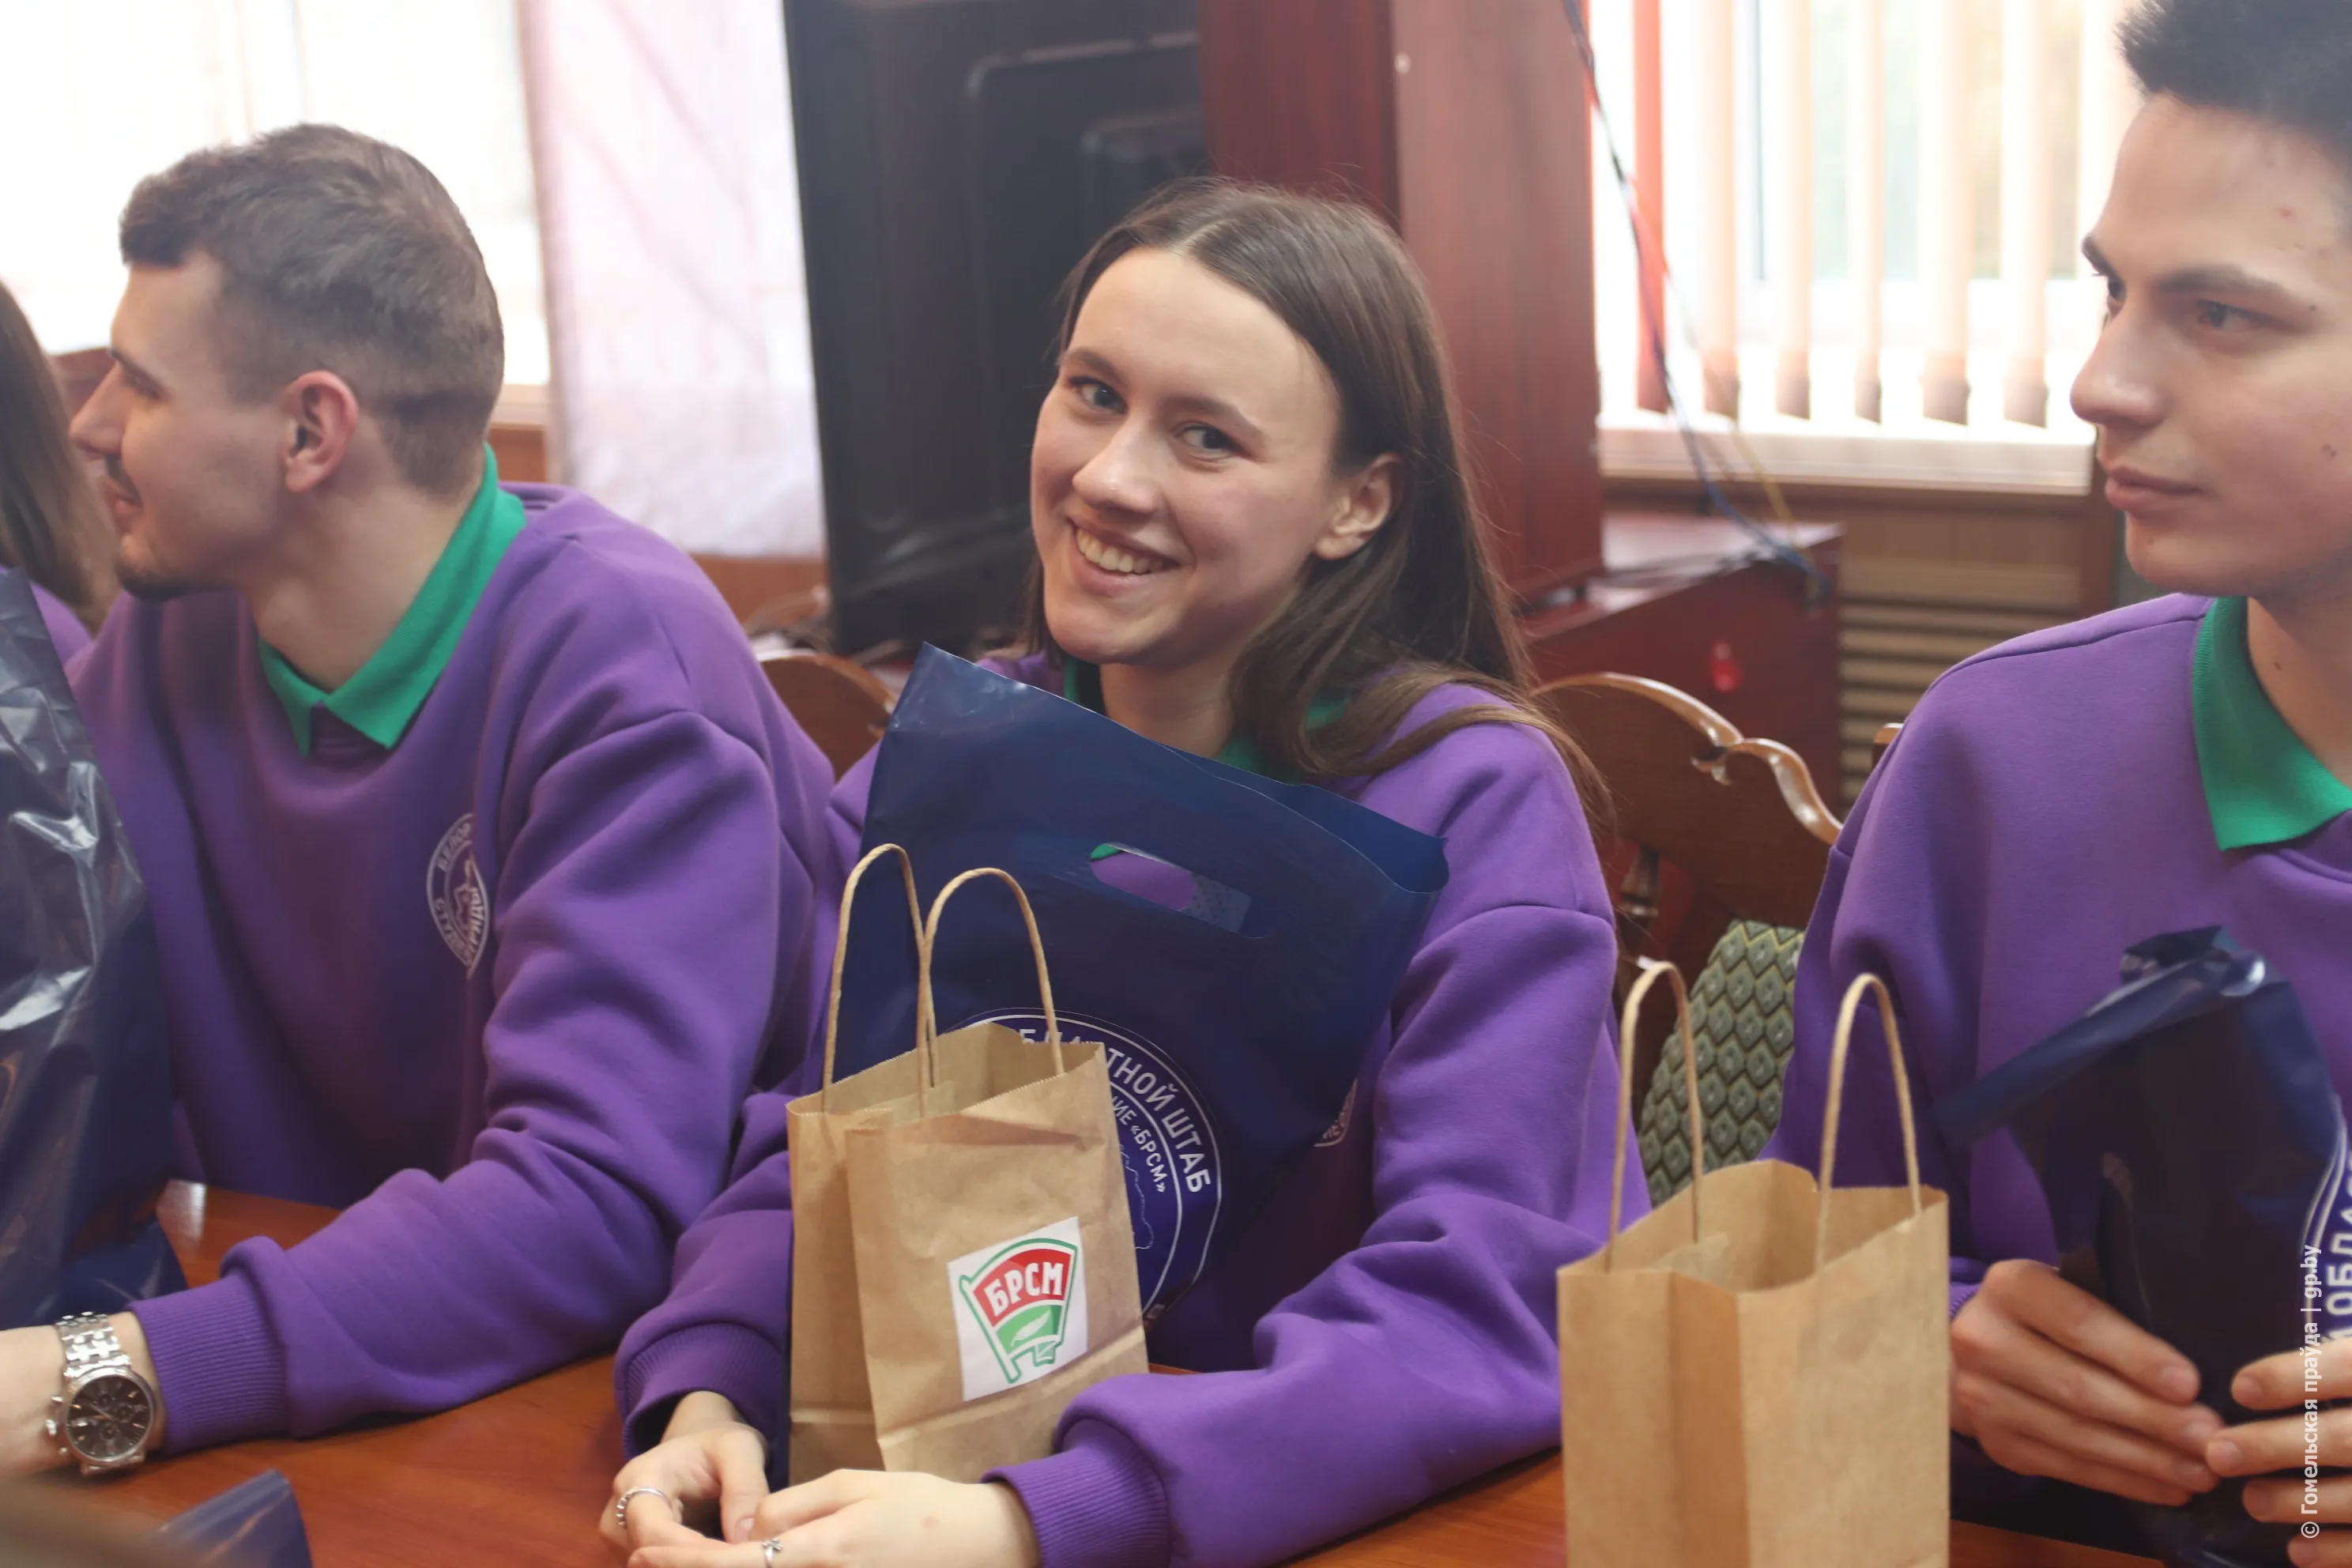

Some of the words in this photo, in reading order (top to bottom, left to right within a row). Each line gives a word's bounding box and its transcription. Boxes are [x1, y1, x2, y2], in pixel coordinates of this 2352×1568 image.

[1129, 1125, 1167, 1193] «БРСМ»
[1161, 1108, 1211, 1193] ШТАБ
[984, 1261, 1065, 1317] БРСМ
